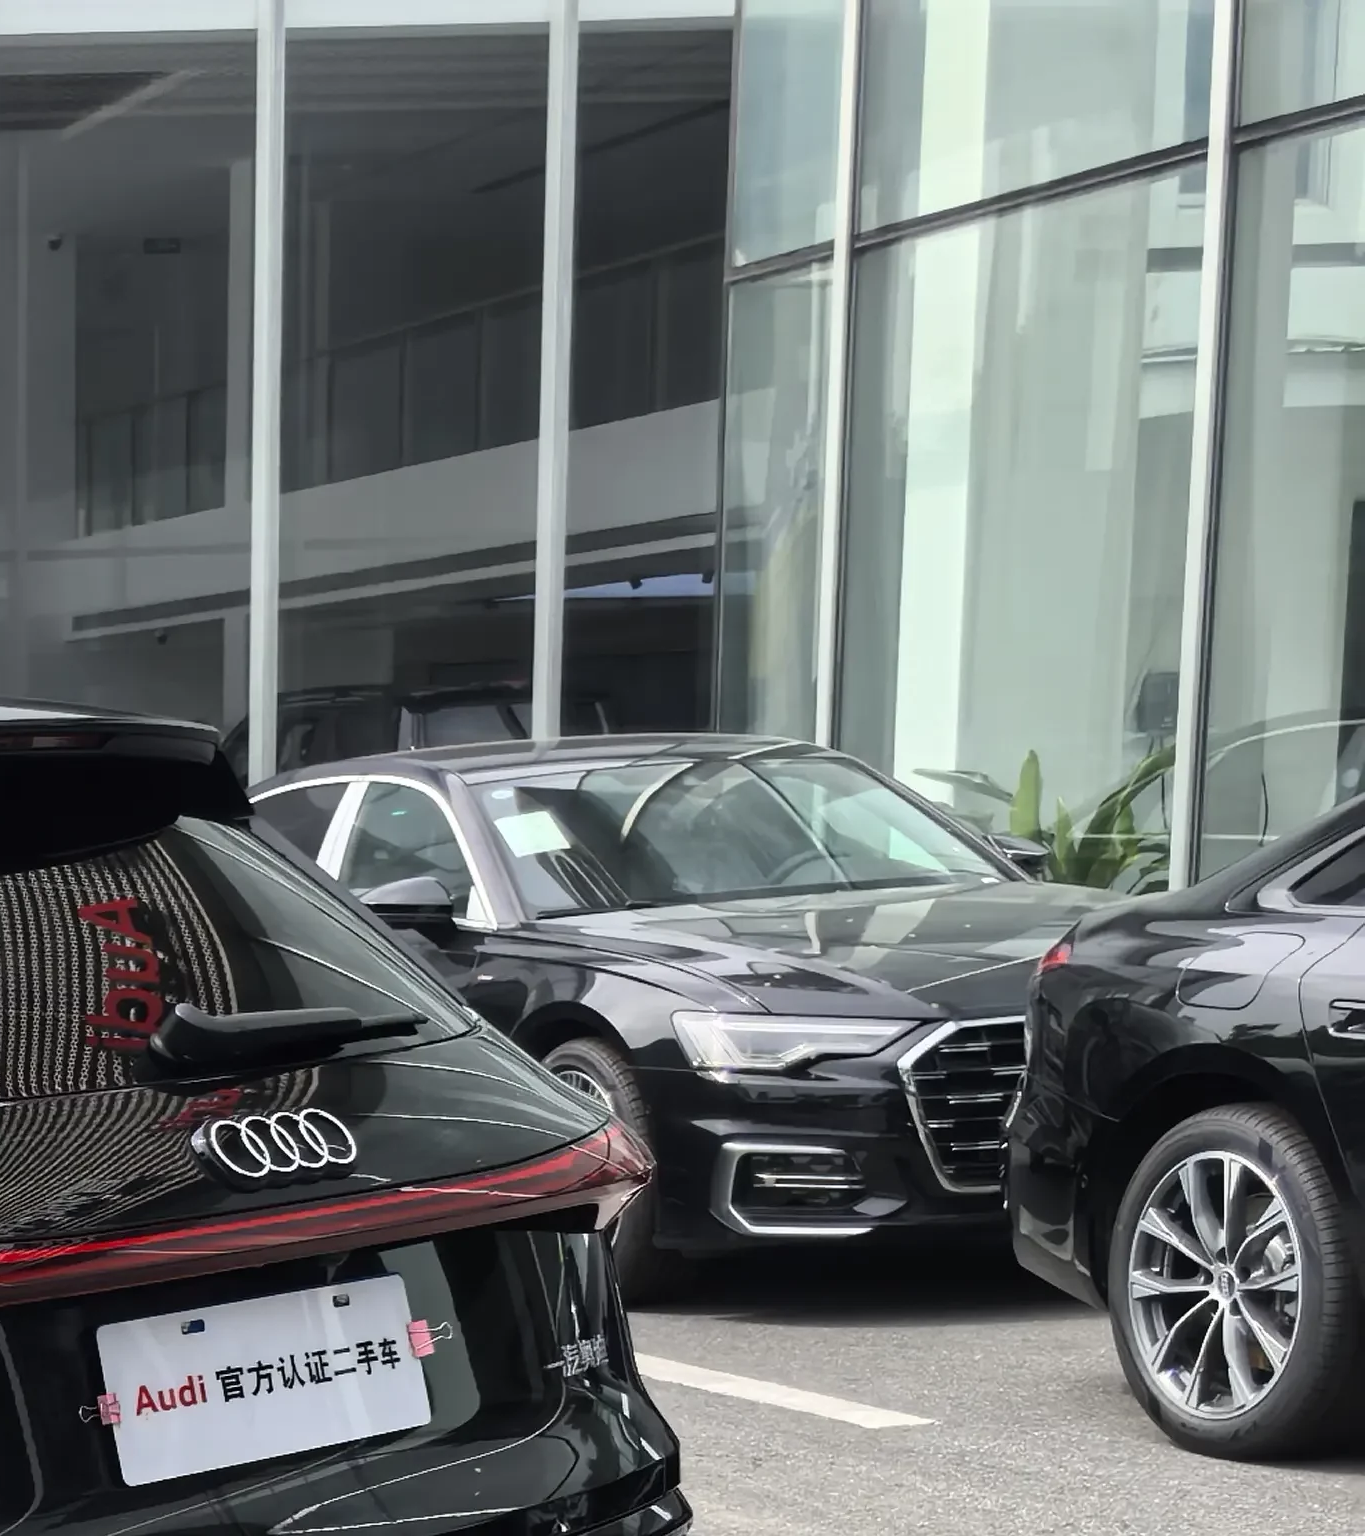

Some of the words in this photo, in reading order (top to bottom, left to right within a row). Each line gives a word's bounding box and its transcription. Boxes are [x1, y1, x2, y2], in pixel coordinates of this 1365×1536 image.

[134, 1375, 209, 1420] Audi
[214, 1336, 403, 1404] 官方认证二手车
